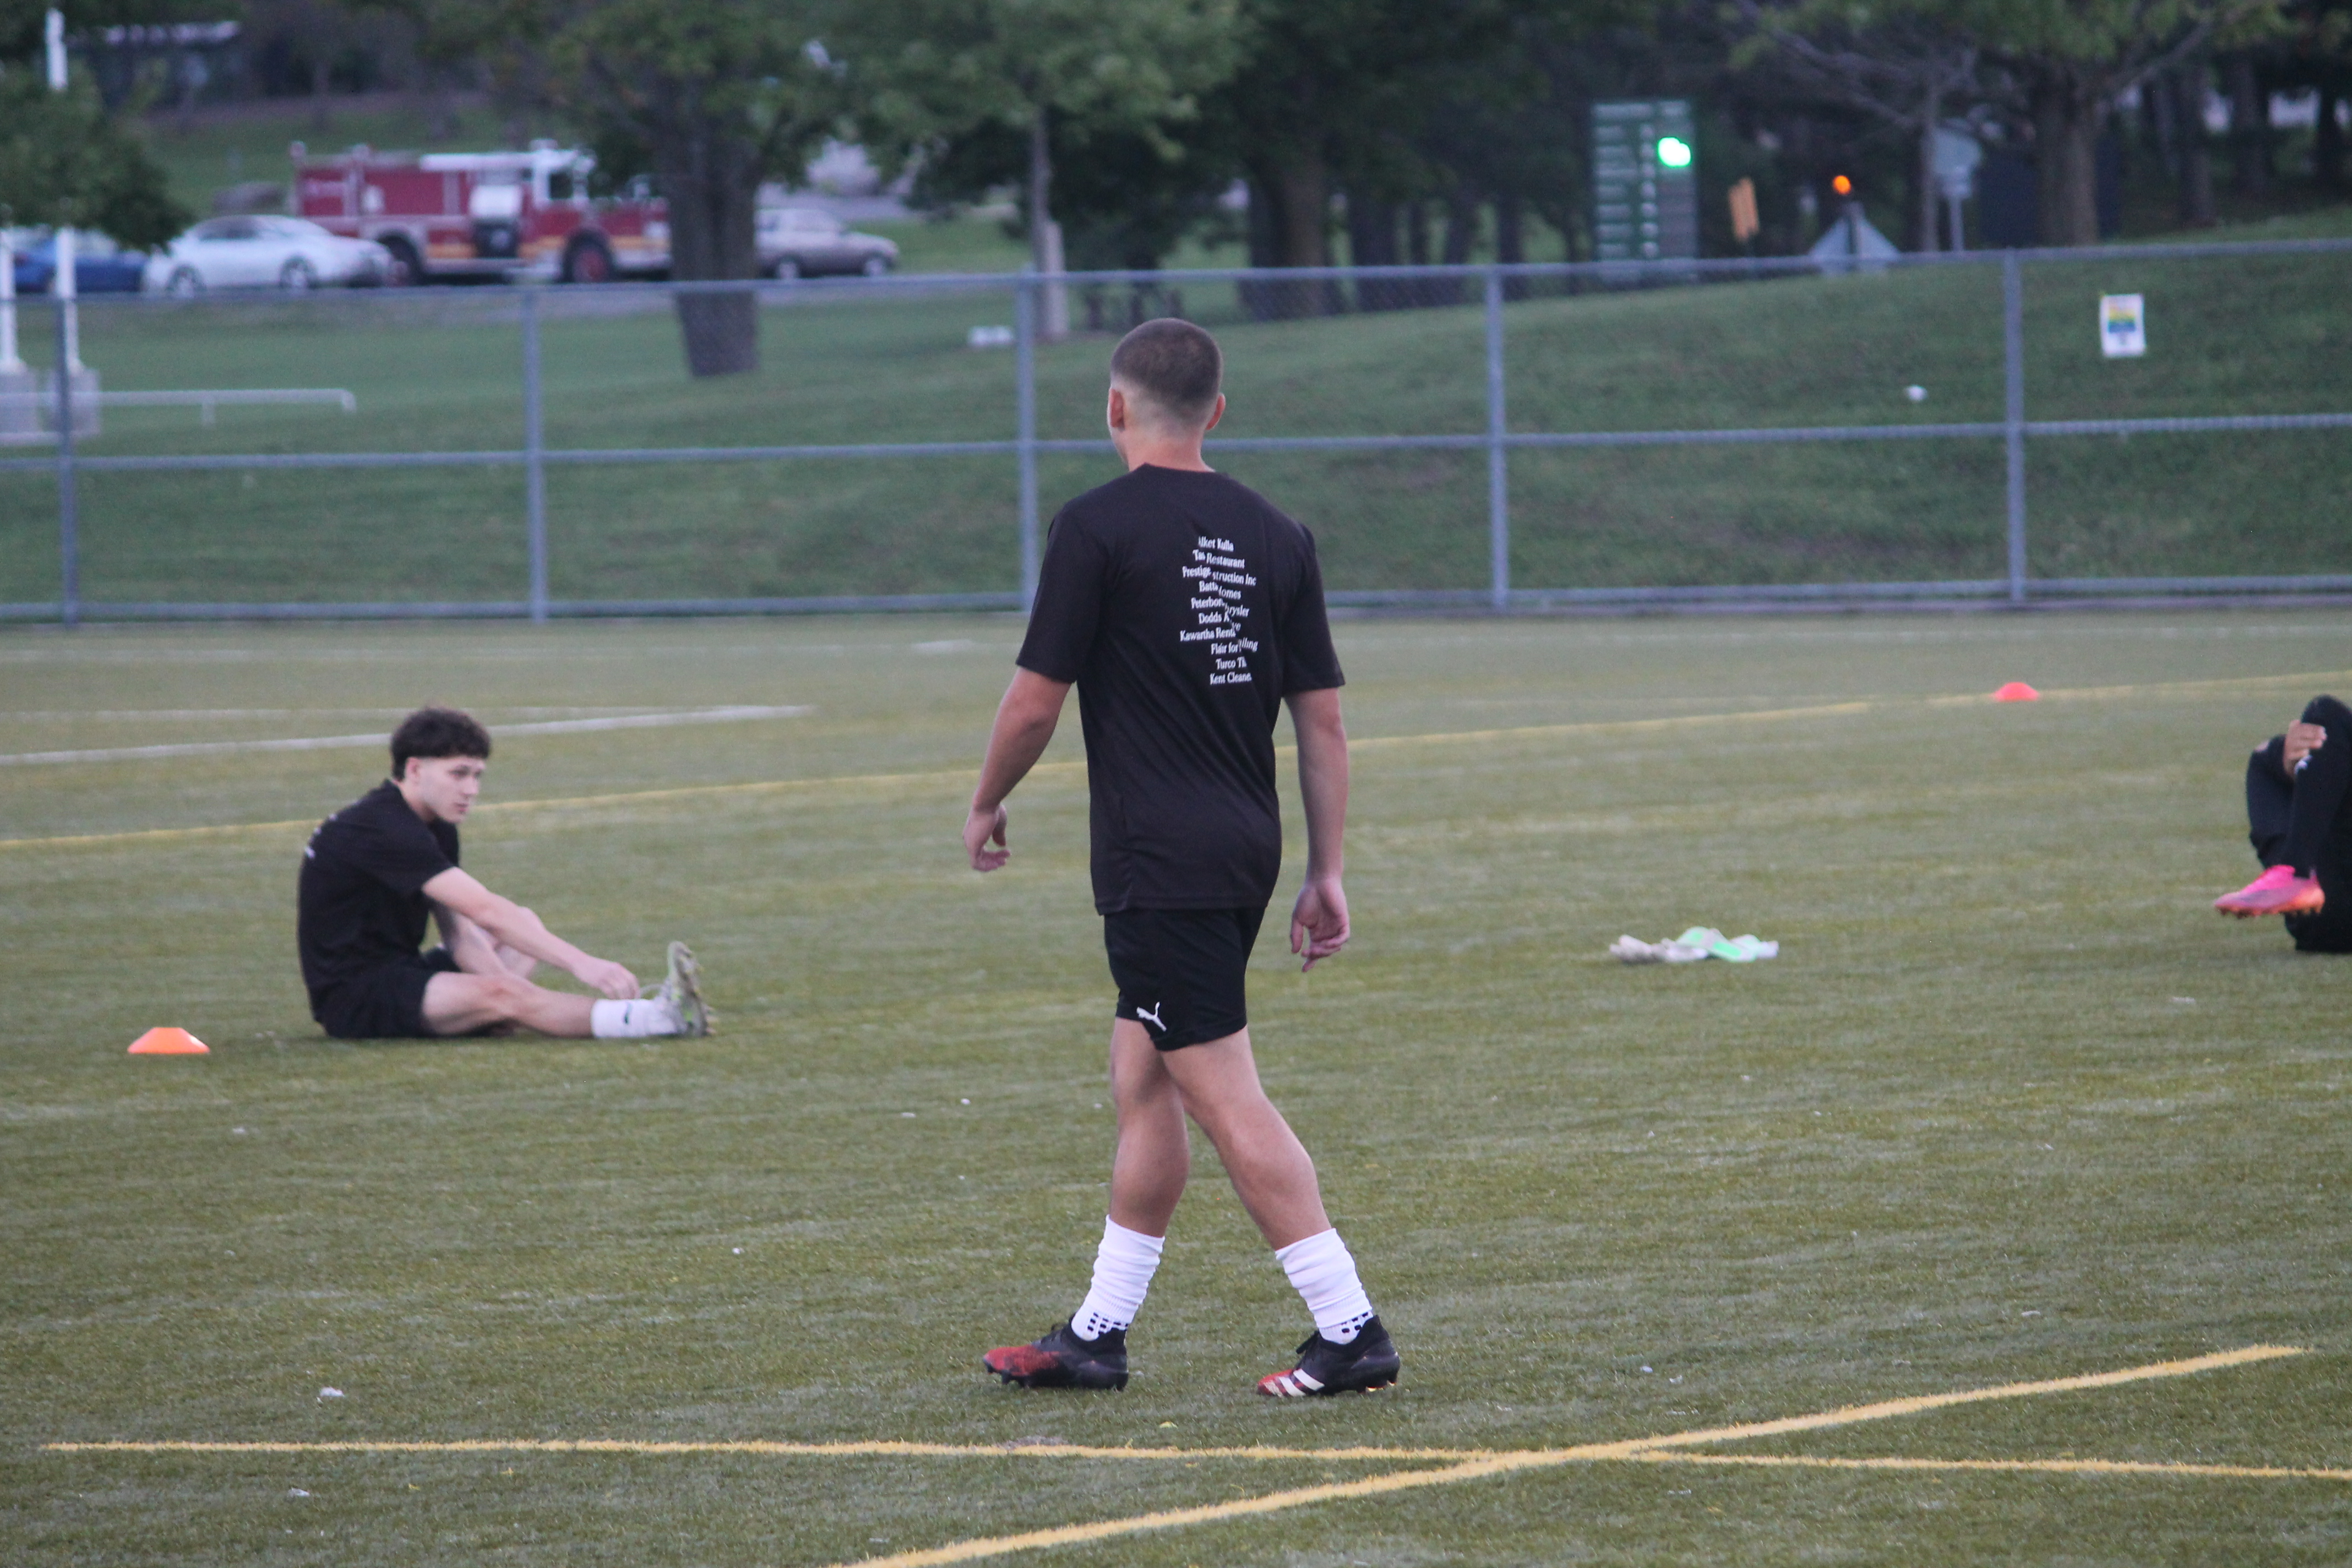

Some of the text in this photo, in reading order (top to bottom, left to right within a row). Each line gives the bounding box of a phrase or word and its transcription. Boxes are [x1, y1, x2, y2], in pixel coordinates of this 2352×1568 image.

[1206, 552, 1245, 569] Restaurant
[1245, 573, 1257, 586] Inc
[1199, 611, 1222, 624] Dodds
[1180, 628, 1215, 642] Kawartha
[1211, 643, 1227, 655] Flair
[1228, 641, 1239, 653] for
[1215, 658, 1237, 670] Turco
[1210, 673, 1226, 685] Kent
